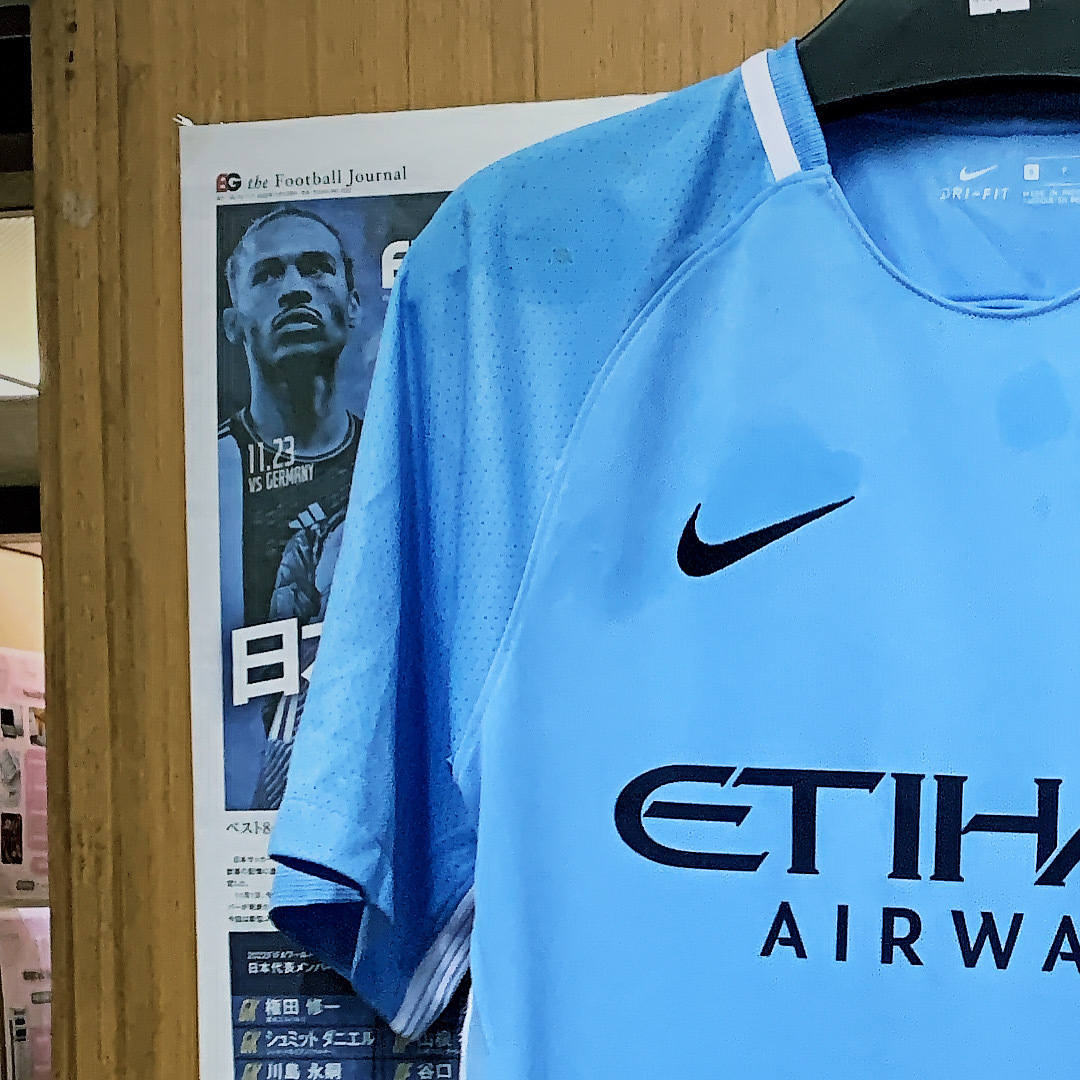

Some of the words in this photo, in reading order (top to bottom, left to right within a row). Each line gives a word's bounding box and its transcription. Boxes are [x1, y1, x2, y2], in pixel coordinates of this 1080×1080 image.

[247, 175, 268, 189] the
[275, 169, 341, 188] Football
[345, 166, 406, 187] Journal
[939, 187, 1010, 200] DRI-FIT
[248, 435, 295, 474] 11.23
[248, 477, 263, 493] VS
[266, 464, 315, 490] GERMANY
[417, 1063, 453, 1080] 谷口
